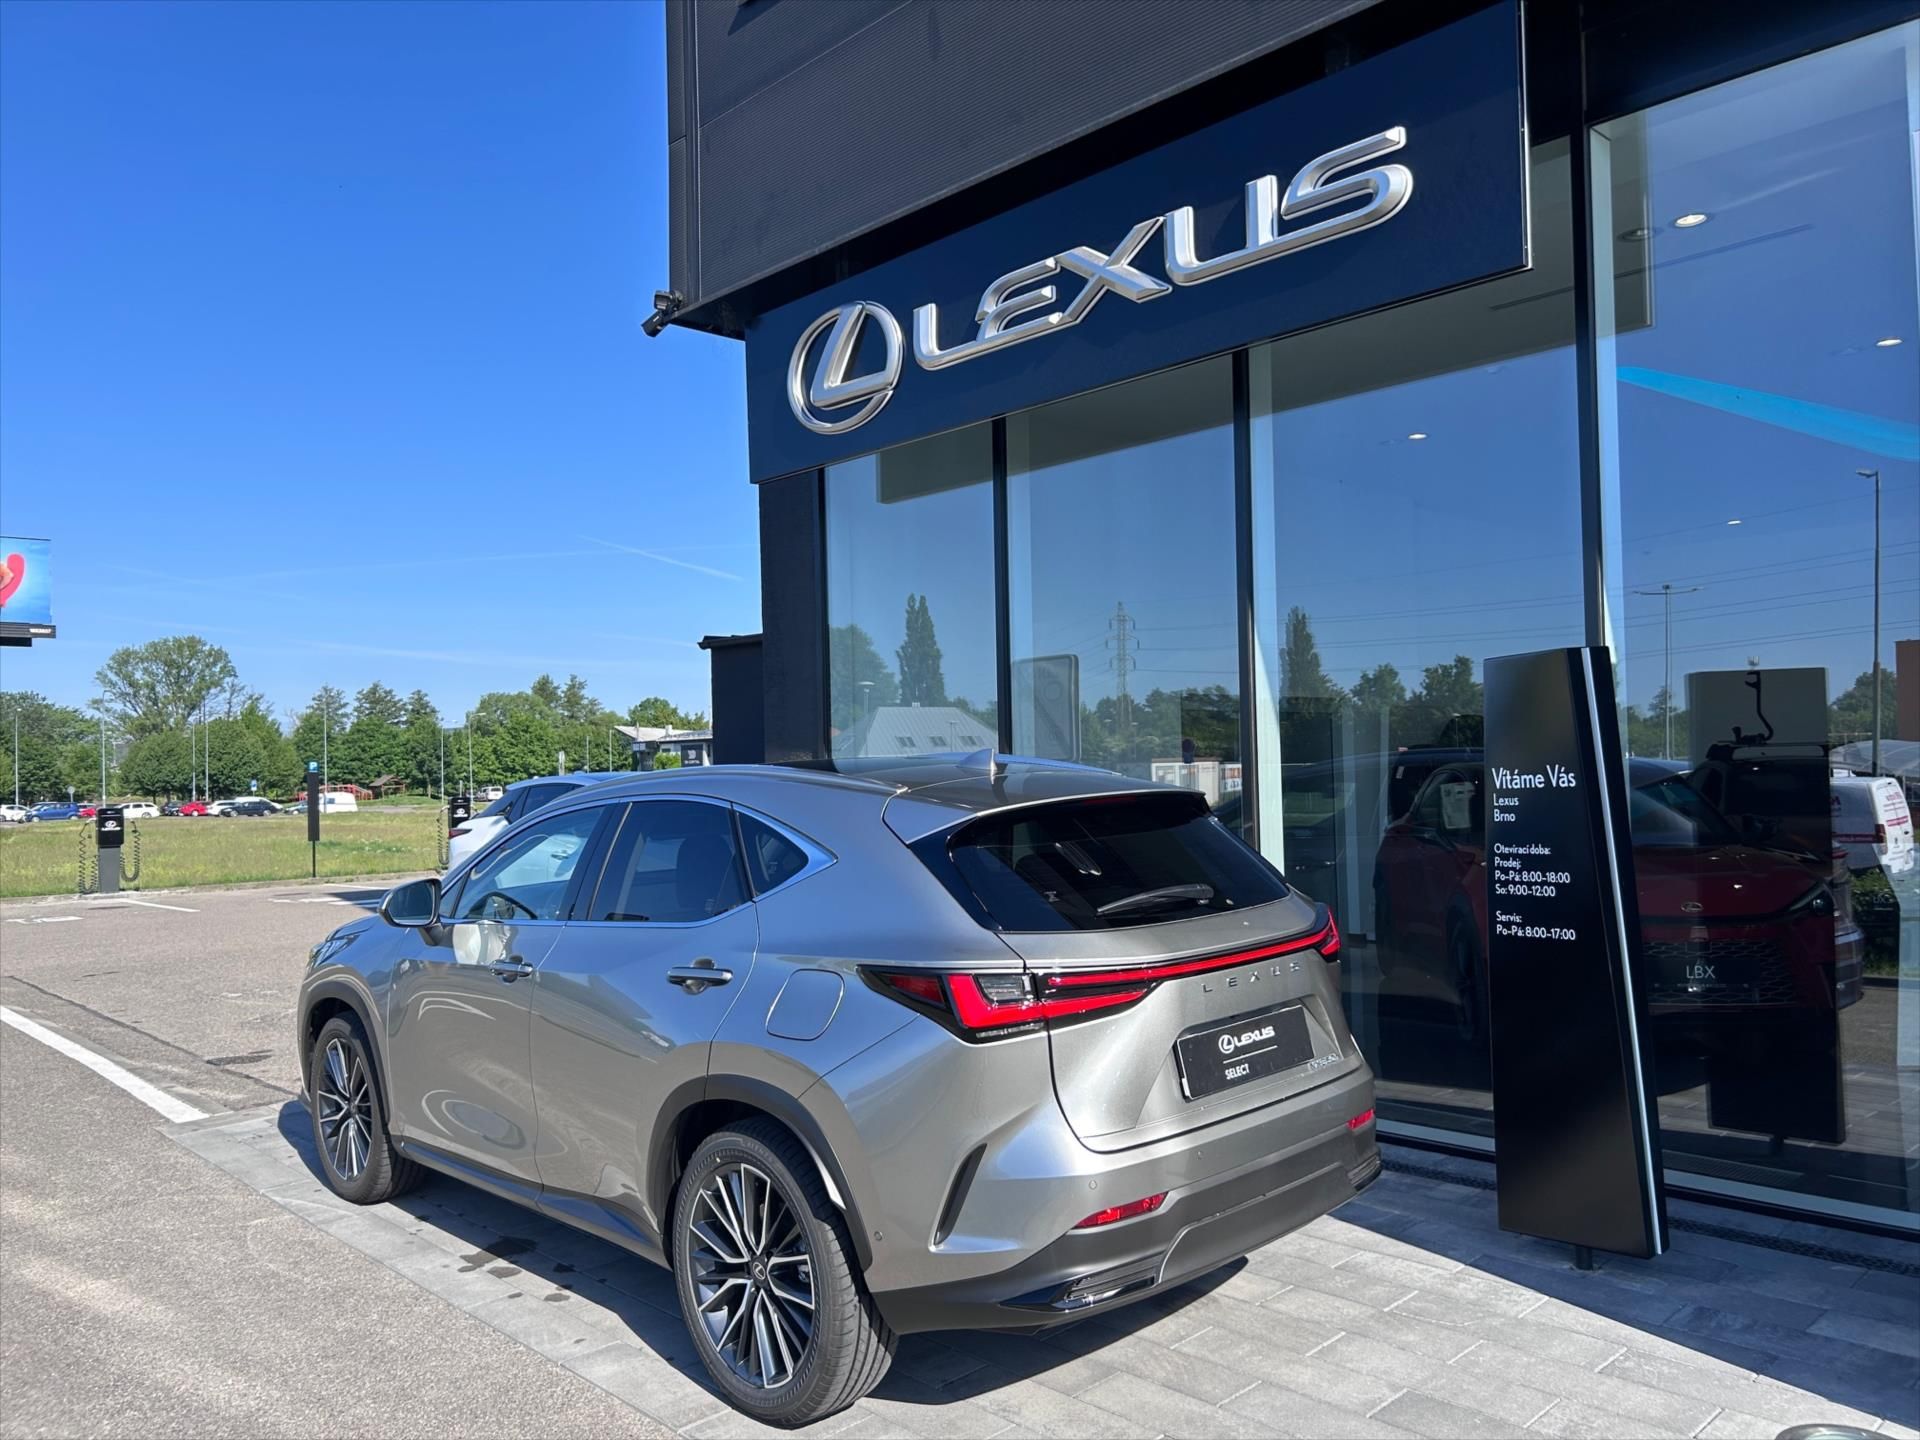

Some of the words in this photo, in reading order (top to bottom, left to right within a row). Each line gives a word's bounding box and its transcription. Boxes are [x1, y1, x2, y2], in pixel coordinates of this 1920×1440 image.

[911, 125, 1414, 371] LEXUS
[1492, 767, 1545, 789] Vítáme
[1546, 764, 1576, 788] Vás
[1493, 793, 1519, 807] Lexus
[1493, 809, 1516, 822] Brno
[1530, 843, 1552, 855] doba:
[1494, 856, 1522, 870] Prodej:
[1495, 883, 1508, 895] So:
[1496, 910, 1522, 923] Servis:
[1201, 961, 1301, 994] LEXUS
[1686, 965, 1716, 979] LBX
[1233, 1025, 1276, 1047] LEXUS
[1225, 1063, 1250, 1080] SELECT
